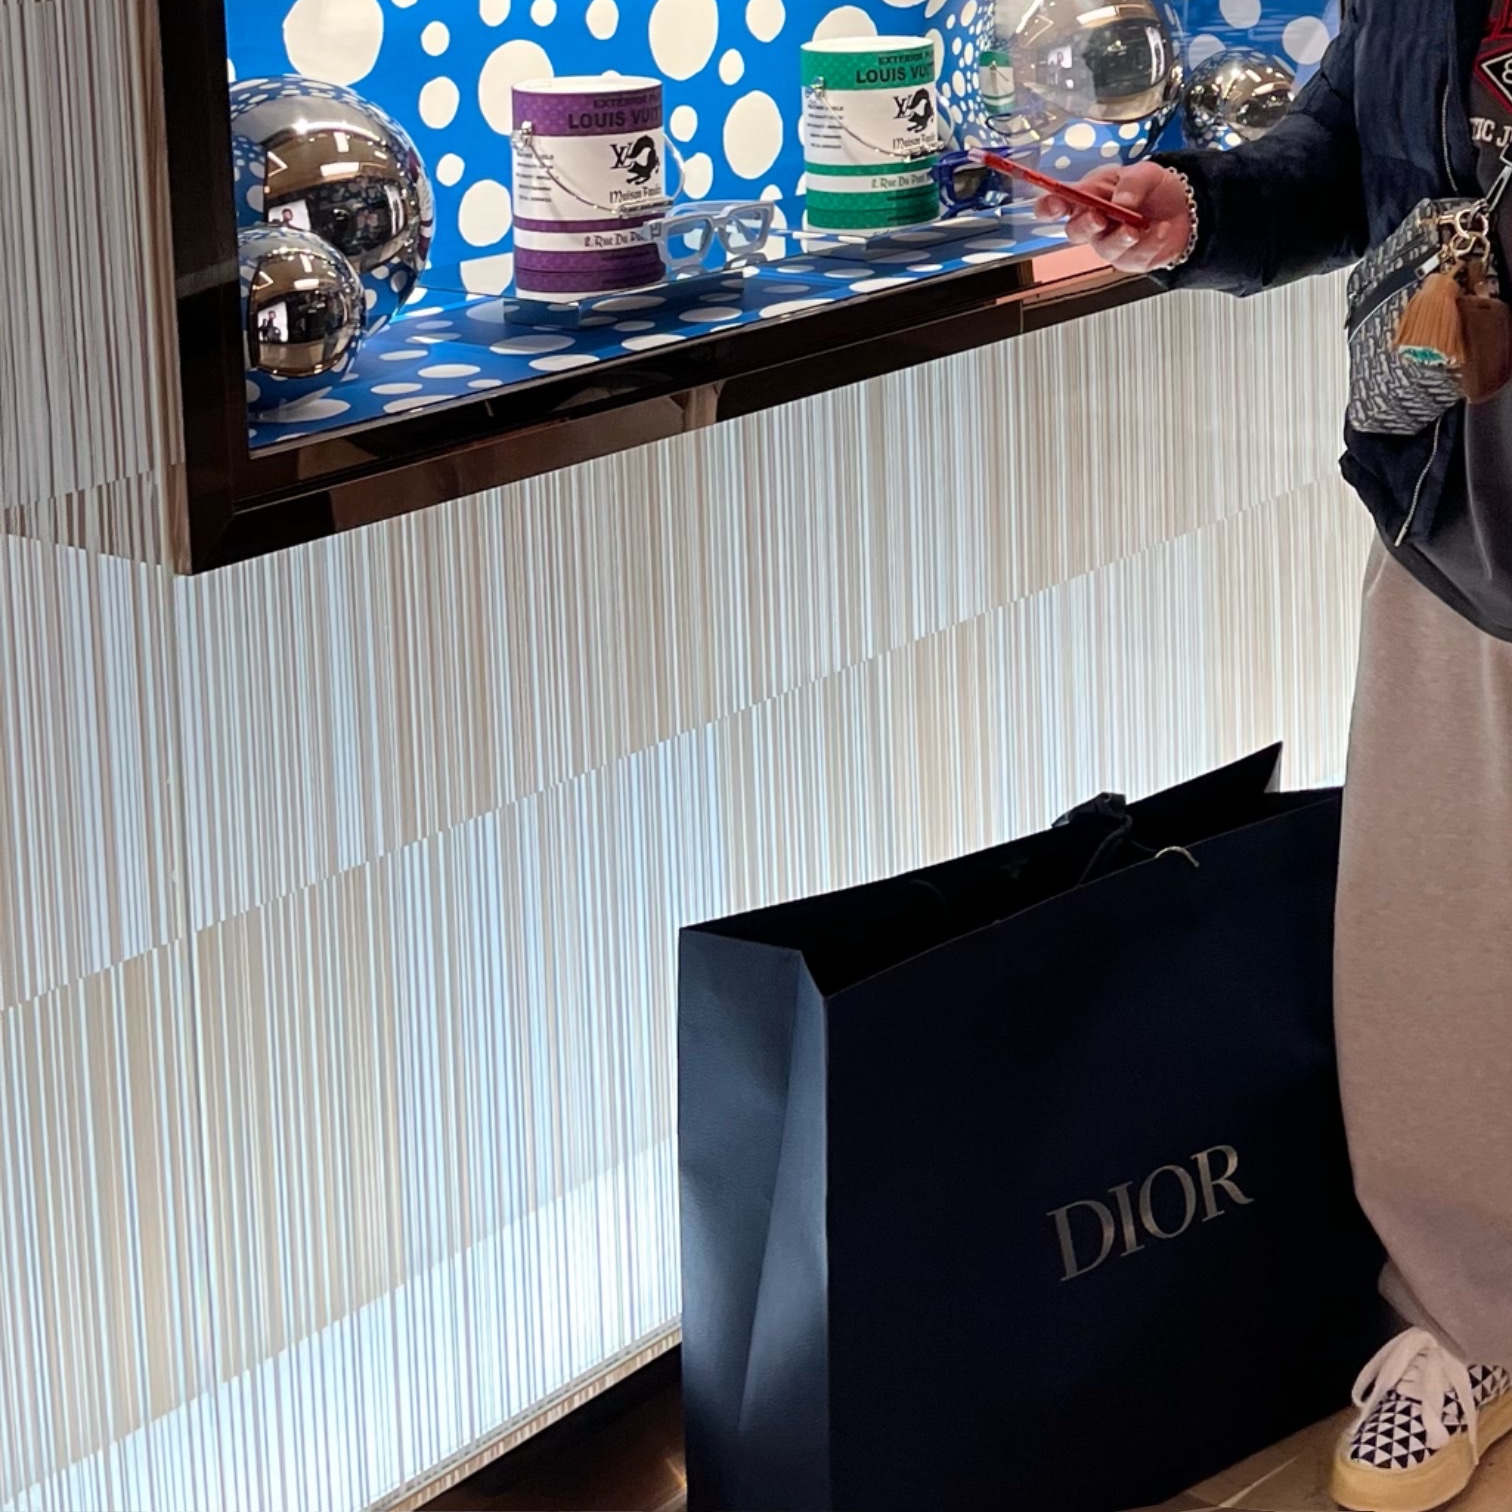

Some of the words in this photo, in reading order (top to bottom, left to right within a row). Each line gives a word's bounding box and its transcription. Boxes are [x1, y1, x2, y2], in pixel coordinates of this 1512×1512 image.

[856, 67, 906, 83] LOUIS
[568, 111, 625, 129] LOUIS
[1046, 1144, 1254, 1283] DIOR
